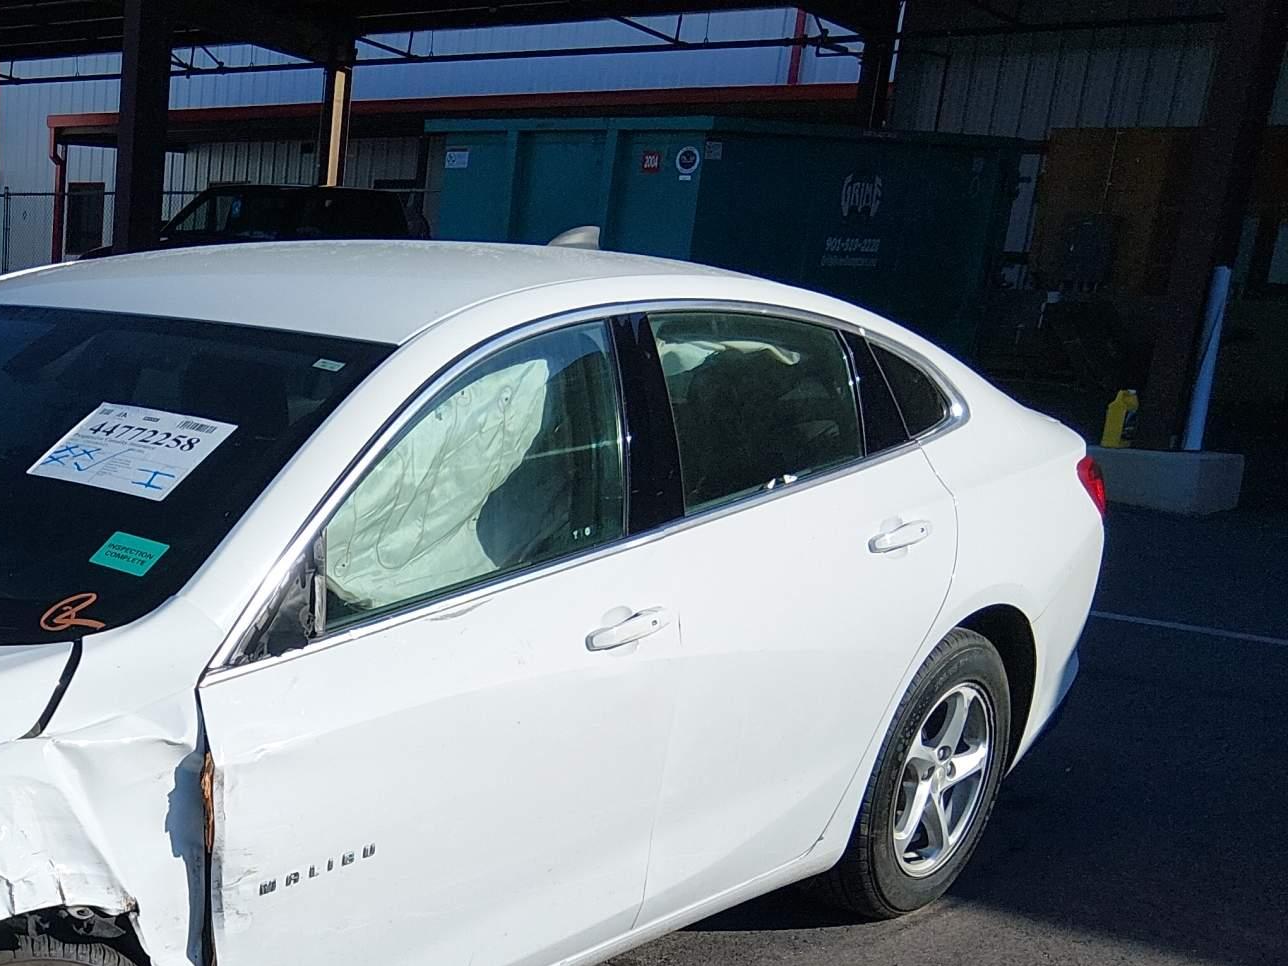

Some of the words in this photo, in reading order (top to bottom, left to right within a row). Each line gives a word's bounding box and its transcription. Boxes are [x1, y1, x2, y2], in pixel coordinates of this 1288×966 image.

[89, 421, 201, 452] 44772258
[104, 550, 147, 566] COMPLETE
[107, 543, 154, 560] INSPECTION
[258, 842, 376, 896] MALIBU
